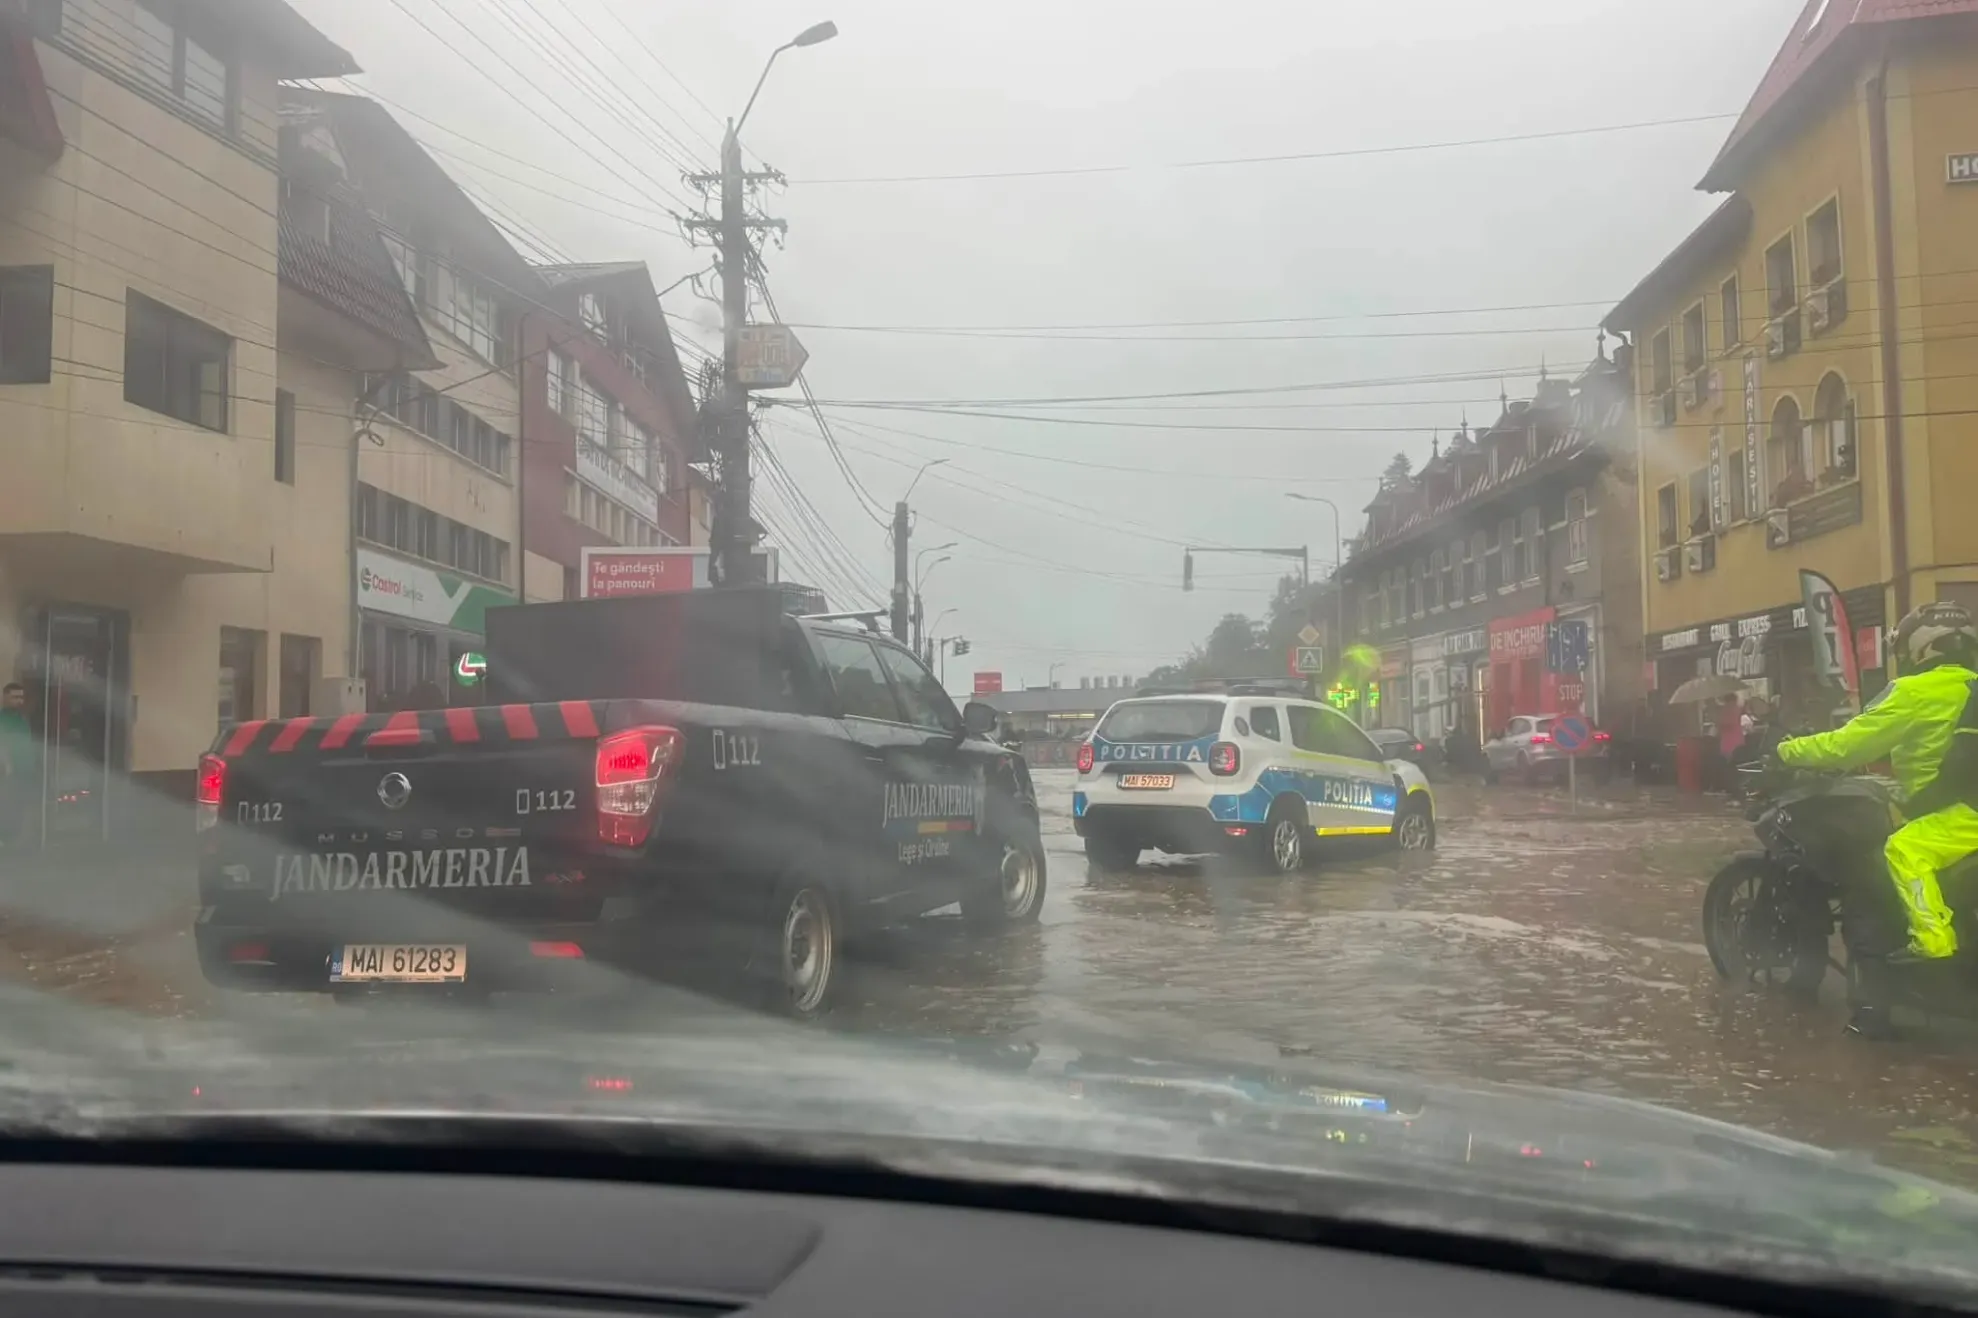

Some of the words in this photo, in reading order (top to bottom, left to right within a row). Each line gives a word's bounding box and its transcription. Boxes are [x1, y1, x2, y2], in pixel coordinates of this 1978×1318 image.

[1711, 446, 1721, 524] HOTEL
[594, 561, 607, 574] Te
[372, 573, 402, 595] Castrol
[593, 574, 604, 589] la
[607, 577, 656, 592] panouri
[1738, 615, 1771, 638] EXPRESS
[1490, 632, 1503, 651] DE
[1560, 683, 1583, 701] STOP
[729, 736, 762, 765] 112
[1141, 775, 1170, 787] 57033
[535, 790, 576, 811] 112
[1324, 780, 1373, 806] POLITIA
[251, 803, 283, 822] 112
[882, 783, 974, 828] JANDARMERIA
[317, 827, 474, 844] MUSSO
[898, 841, 917, 865] Lege
[269, 846, 533, 901] JANDARMERIA
[351, 948, 384, 974] MAI
[392, 947, 457, 974] 61283
